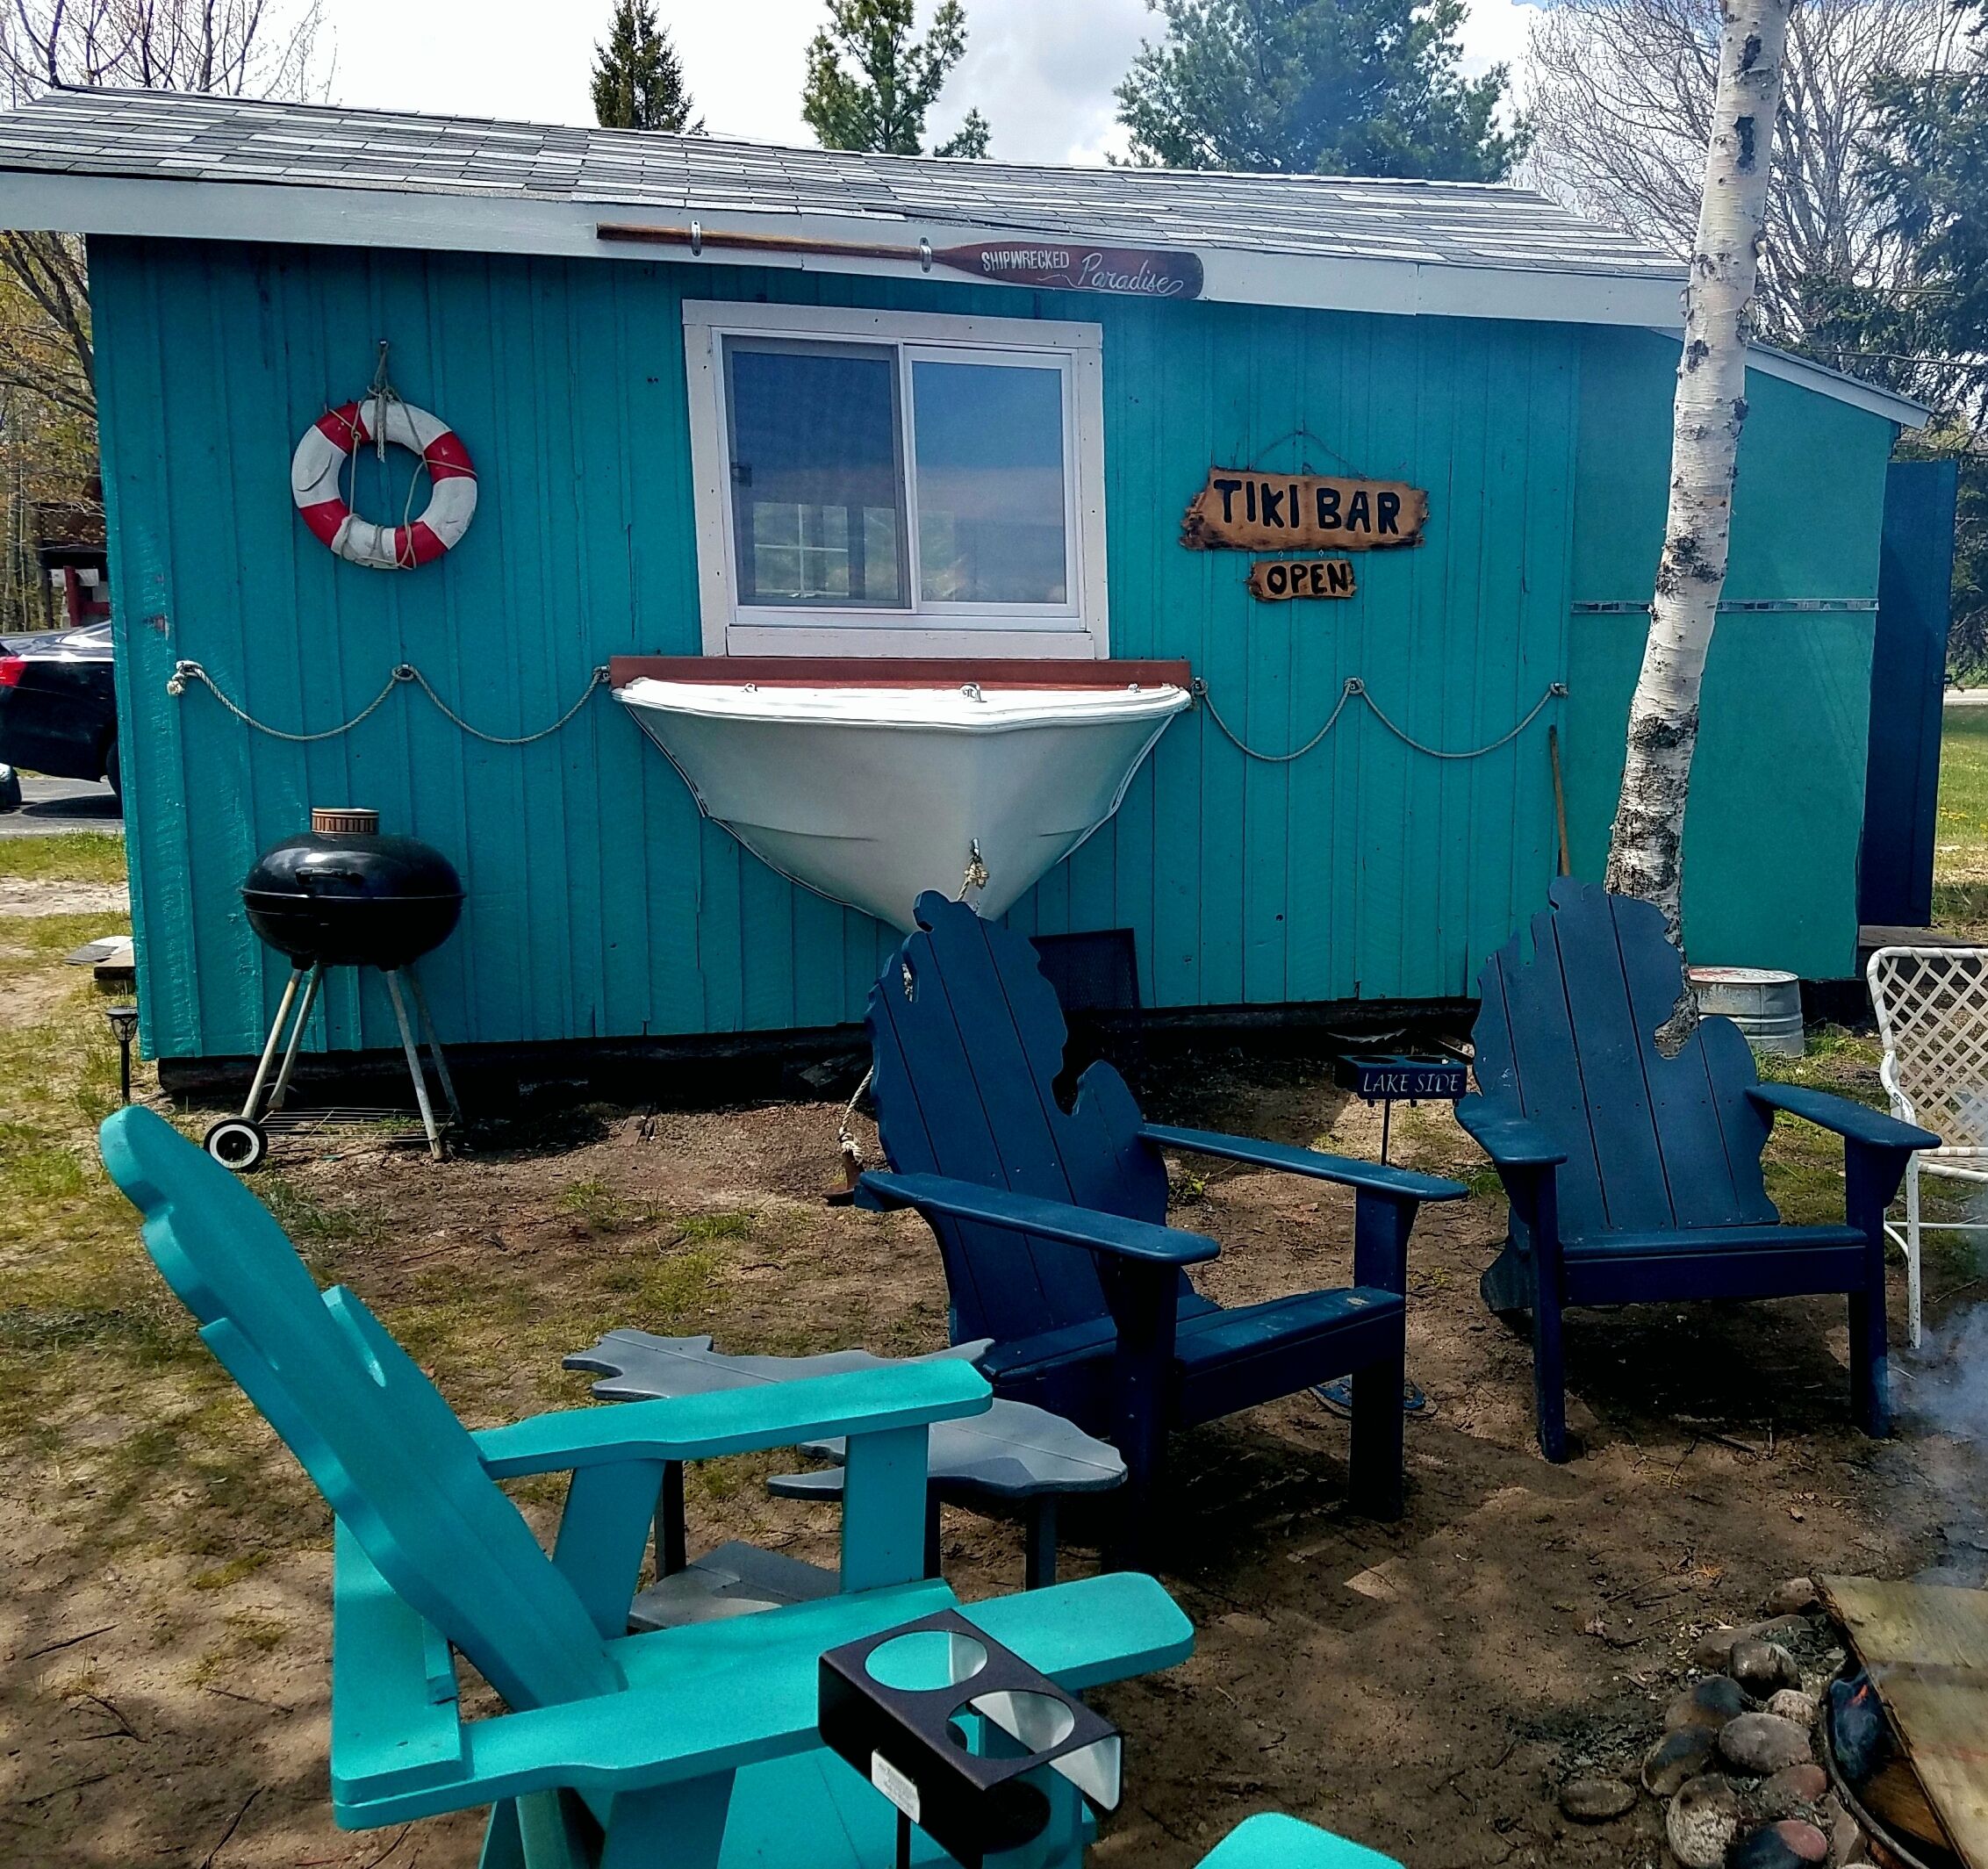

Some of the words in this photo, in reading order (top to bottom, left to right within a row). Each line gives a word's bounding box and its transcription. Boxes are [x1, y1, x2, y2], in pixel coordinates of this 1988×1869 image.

[980, 249, 1070, 272] SHIPWRECKED
[1080, 253, 1183, 296] Paradise
[1213, 479, 1300, 528] TIKI
[1316, 487, 1402, 535] BAR
[1267, 563, 1350, 594] OPEN
[1363, 1072, 1410, 1093] LAKE
[1415, 1074, 1460, 1093] SIDE
